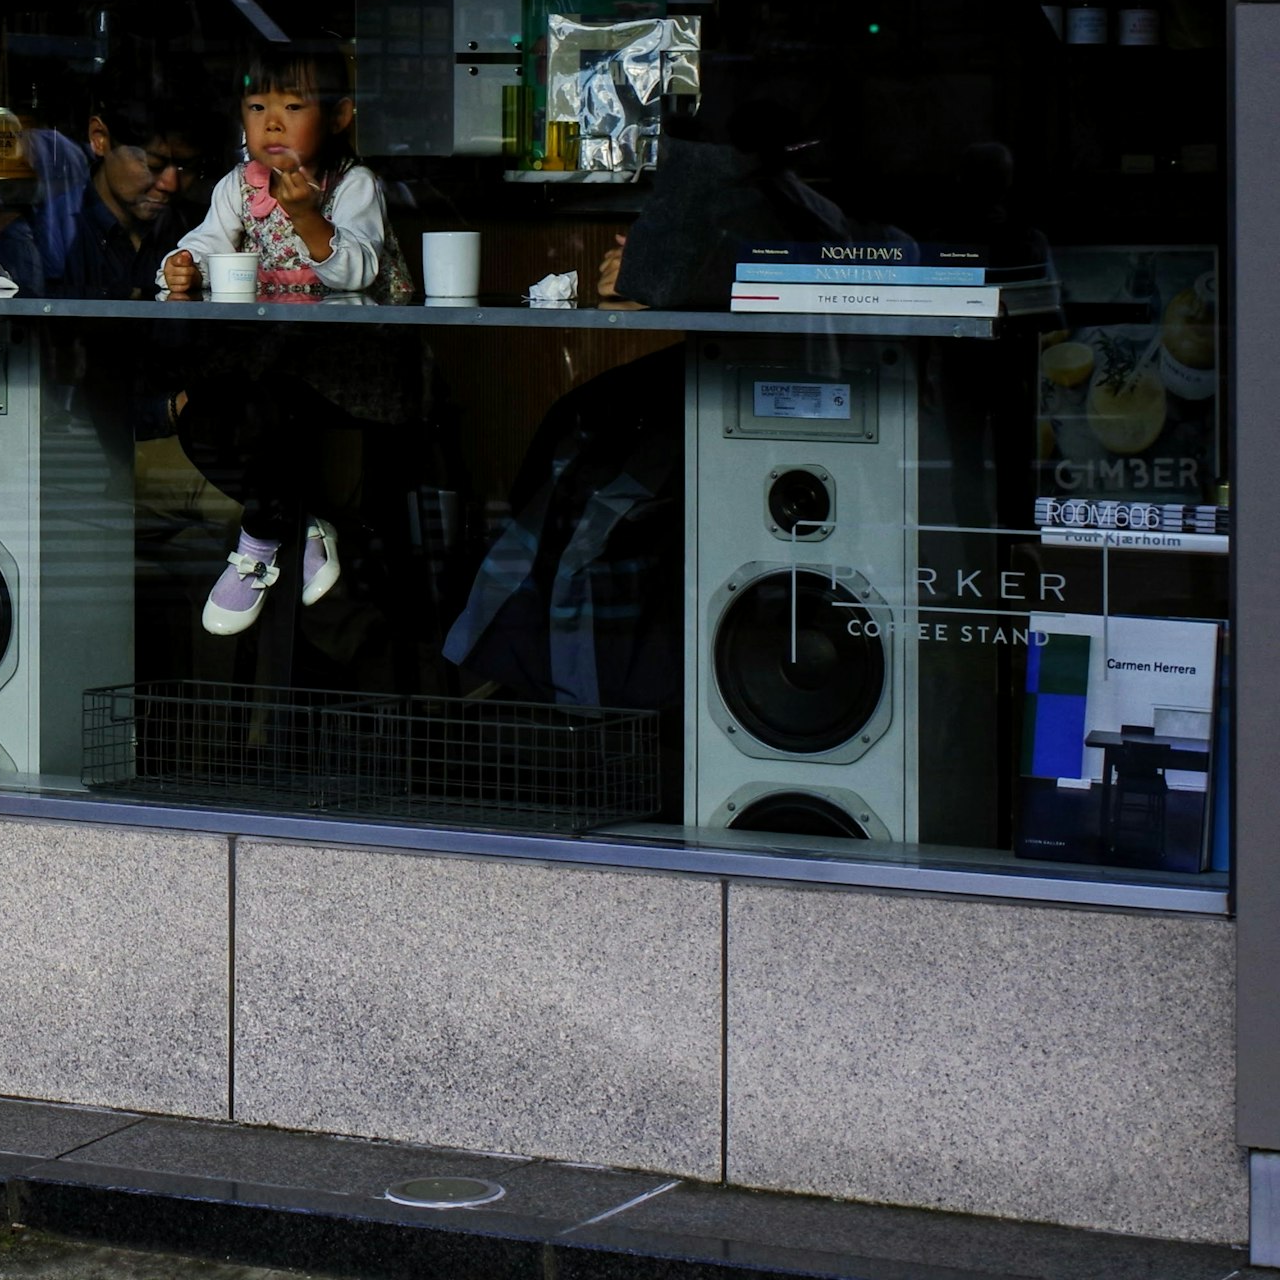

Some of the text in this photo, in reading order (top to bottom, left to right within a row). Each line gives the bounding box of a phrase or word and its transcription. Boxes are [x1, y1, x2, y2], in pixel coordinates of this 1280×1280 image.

[821, 246, 903, 260] NOAH DAVIS
[818, 295, 838, 303] THE
[843, 295, 879, 303] TOUCH
[1054, 456, 1199, 490] GIMBER
[1113, 506, 1160, 529] 606
[831, 565, 1067, 602] PRKER
[960, 625, 1050, 646] STAND
[1106, 658, 1197, 675] Carmen Herrera
